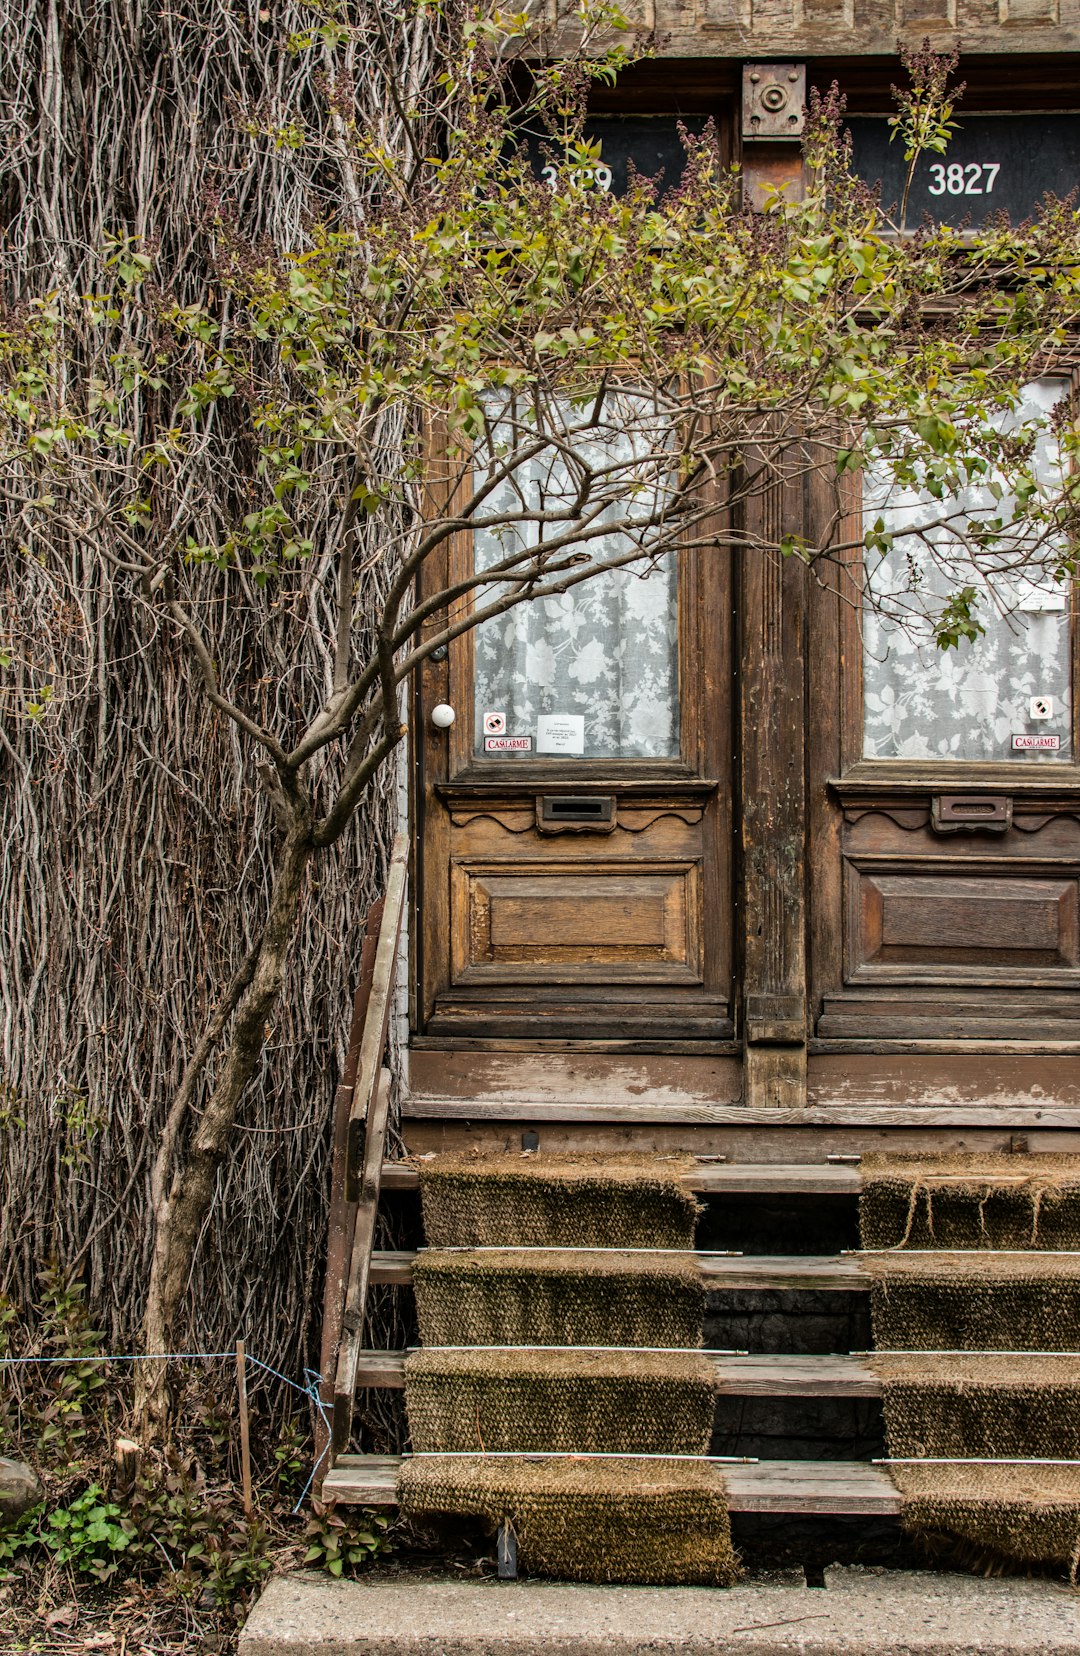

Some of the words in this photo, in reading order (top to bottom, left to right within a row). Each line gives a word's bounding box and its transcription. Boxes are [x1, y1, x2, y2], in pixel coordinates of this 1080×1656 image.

[928, 163, 1001, 195] 3827
[487, 739, 529, 749] CASALARME
[1015, 737, 1056, 748] CASALARME
